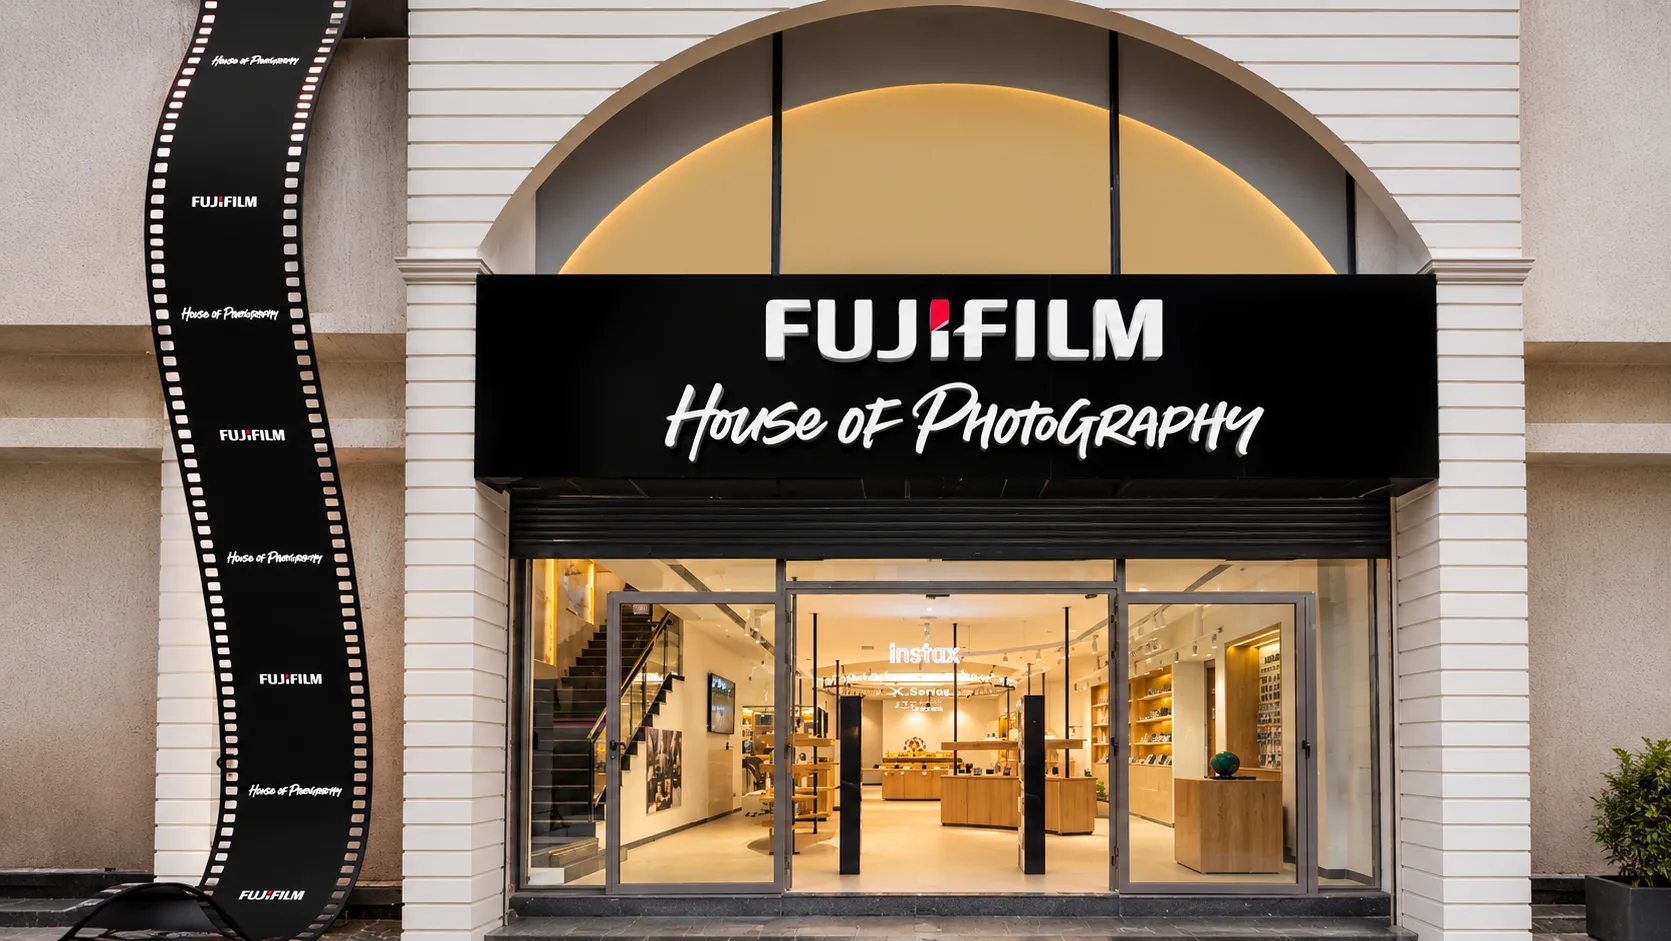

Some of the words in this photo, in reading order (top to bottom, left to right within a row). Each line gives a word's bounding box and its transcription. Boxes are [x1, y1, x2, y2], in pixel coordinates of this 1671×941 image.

[192, 195, 258, 208] FUJIFILM
[765, 298, 1163, 362] FUJIFILM
[219, 428, 286, 442] FUJIFILM
[259, 673, 323, 685] FUJIFILM
[238, 889, 306, 902] FUJIFILM
